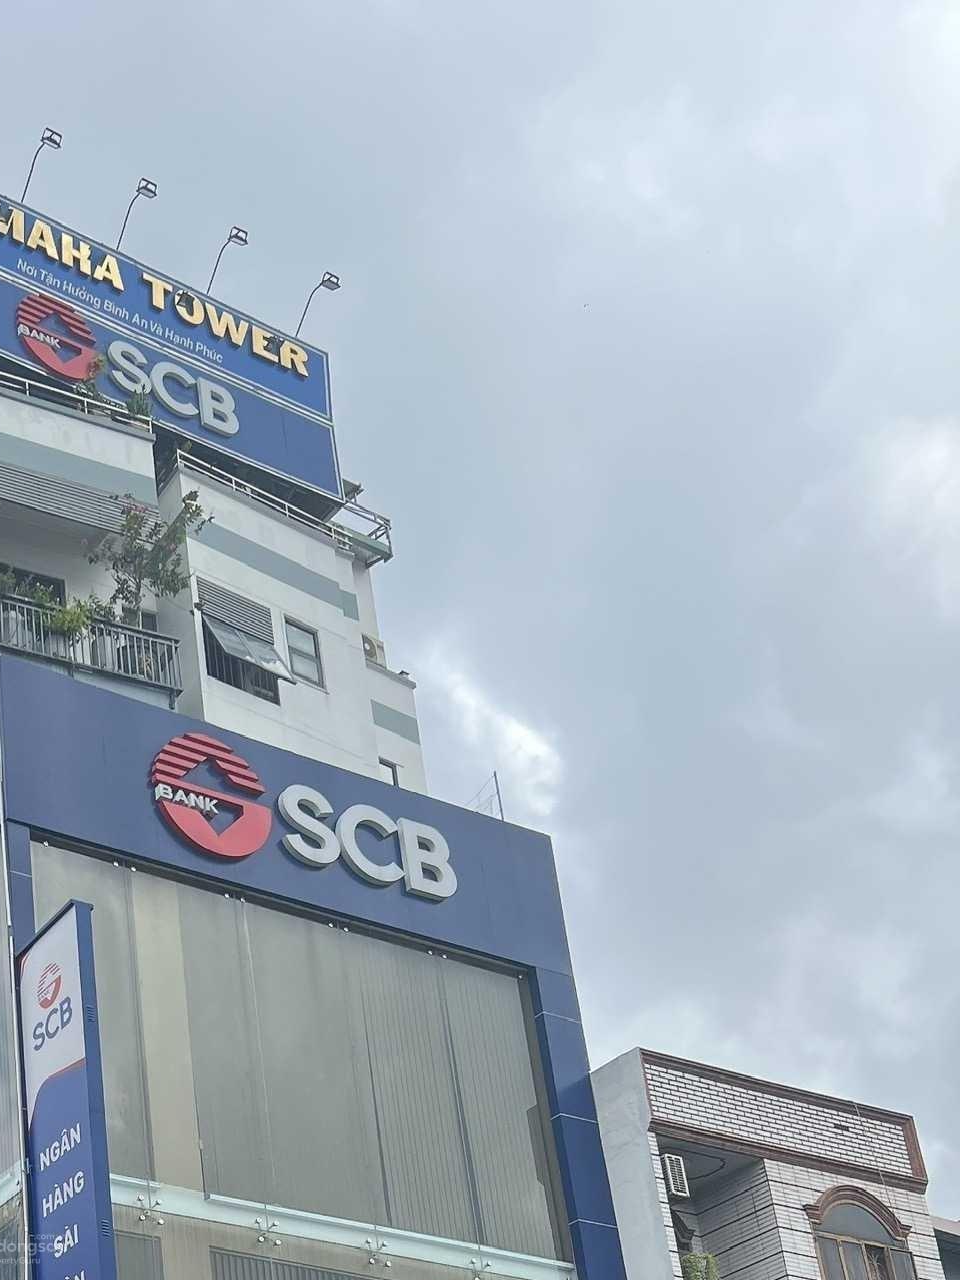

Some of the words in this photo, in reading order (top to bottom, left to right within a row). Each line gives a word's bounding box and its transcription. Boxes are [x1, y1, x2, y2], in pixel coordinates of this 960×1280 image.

[17, 323, 62, 349] BANK
[63, 280, 101, 309] Hưởng
[165, 327, 194, 350] Hạnh
[143, 272, 308, 377] TOWER
[106, 340, 240, 436] SCB
[155, 782, 220, 816] BANK
[277, 784, 458, 902] SCB
[32, 995, 74, 1052] SCB
[38, 1122, 82, 1172] NGÂN
[42, 1170, 85, 1219] HÀNG
